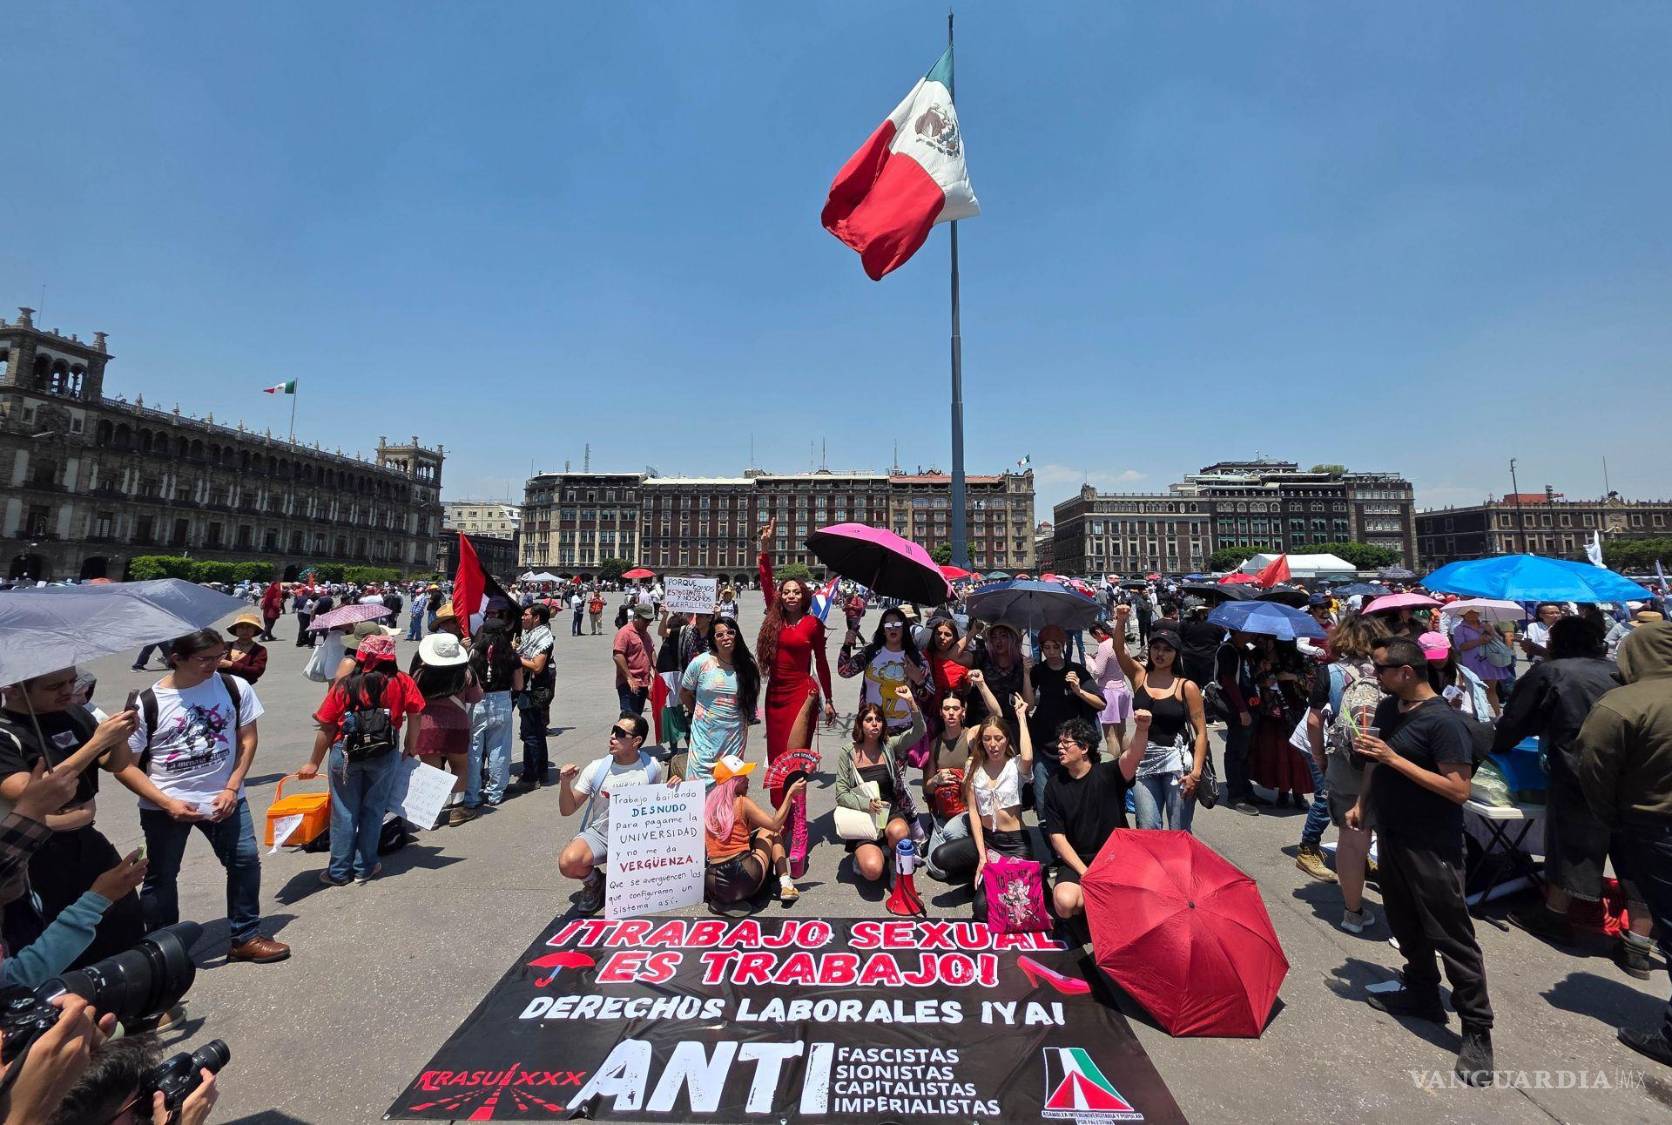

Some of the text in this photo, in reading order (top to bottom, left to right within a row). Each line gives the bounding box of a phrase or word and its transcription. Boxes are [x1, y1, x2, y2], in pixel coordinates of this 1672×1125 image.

[669, 579, 696, 587] PORQUE
[612, 789, 697, 807] Trabajo bailando
[631, 803, 687, 818] DESNUDO
[688, 812, 698, 822] la
[620, 827, 698, 844] UNIVERSIDAD
[626, 850, 638, 858] no
[666, 845, 677, 854] da
[609, 880, 623, 890] Que
[690, 869, 702, 879] los
[608, 893, 622, 906] que
[681, 884, 693, 893] un
[595, 949, 1000, 988] ES TRABAJO!
[519, 995, 725, 1021] DERECHOS
[736, 997, 964, 1025] LABORALES
[838, 1047, 960, 1064] FASCISTAS
[566, 1038, 835, 1115] ANTI
[836, 1064, 955, 1081] SIONISTAS
[834, 1080, 977, 1097] CAPITALISTAS
[834, 1096, 1001, 1116] IMPERIALISTAS
